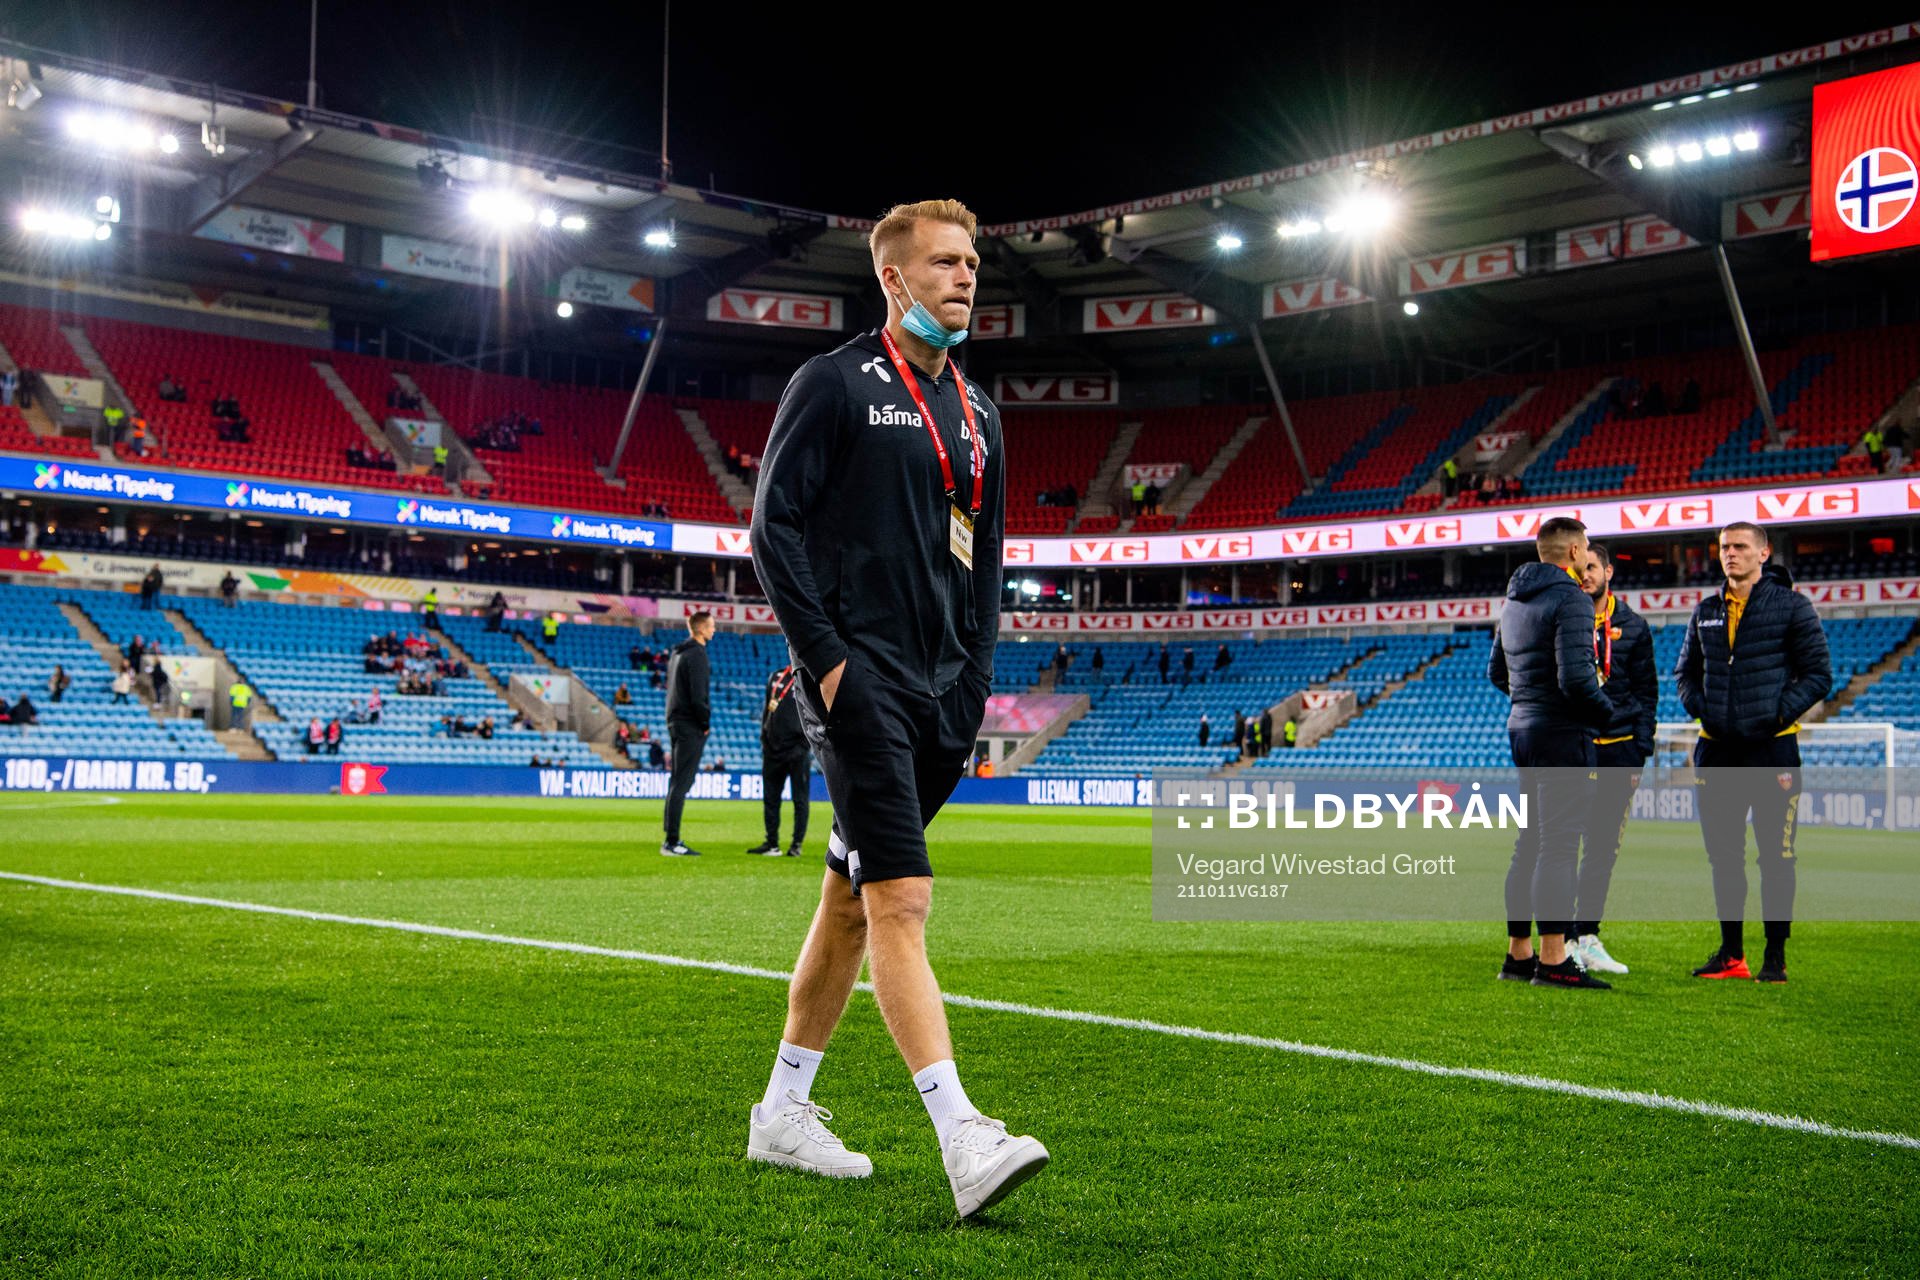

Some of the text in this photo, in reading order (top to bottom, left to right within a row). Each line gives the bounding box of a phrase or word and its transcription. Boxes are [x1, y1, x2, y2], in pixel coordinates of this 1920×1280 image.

[1843, 29, 1892, 52] VG
[1776, 45, 1824, 68] VG
[1714, 60, 1761, 82] VG
[1655, 74, 1700, 97] VG
[1600, 87, 1642, 108] VG
[1492, 111, 1532, 132] VG
[1544, 100, 1587, 120] VG
[1742, 198, 1810, 229] V
[1572, 222, 1681, 258] VG
[1412, 246, 1510, 286] VG
[724, 293, 827, 325] VG
[1100, 299, 1198, 326] VG
[971, 307, 1006, 335] G
[1006, 378, 1105, 401] VG
[63, 470, 175, 501] Norsk Tipping
[251, 488, 351, 517] Norsk Tipping
[1622, 500, 1708, 528] VG
[1758, 489, 1854, 519] VG
[420, 506, 510, 533] Norsk Tipping
[573, 521, 655, 546] Norsk Tipping
[718, 531, 752, 553] V
[1284, 529, 1350, 553] VG
[1386, 520, 1460, 546] VG
[1003, 544, 1031, 562] G
[1072, 542, 1146, 562] VG
[1184, 537, 1251, 559] VG
[1643, 592, 1697, 608] VG
[1883, 582, 1920, 598] V
[749, 607, 776, 621] V
[1015, 614, 1066, 629] VG
[1081, 614, 1131, 629] VG
[1145, 613, 1192, 628] VG
[1205, 612, 1250, 627] VG
[1264, 610, 1307, 625] VG
[1320, 607, 1365, 623] VG
[1378, 605, 1425, 620] VG
[1439, 602, 1489, 618] VG
[174, 762, 217, 793] 50,-
[1083, 780, 1134, 805] STADION
